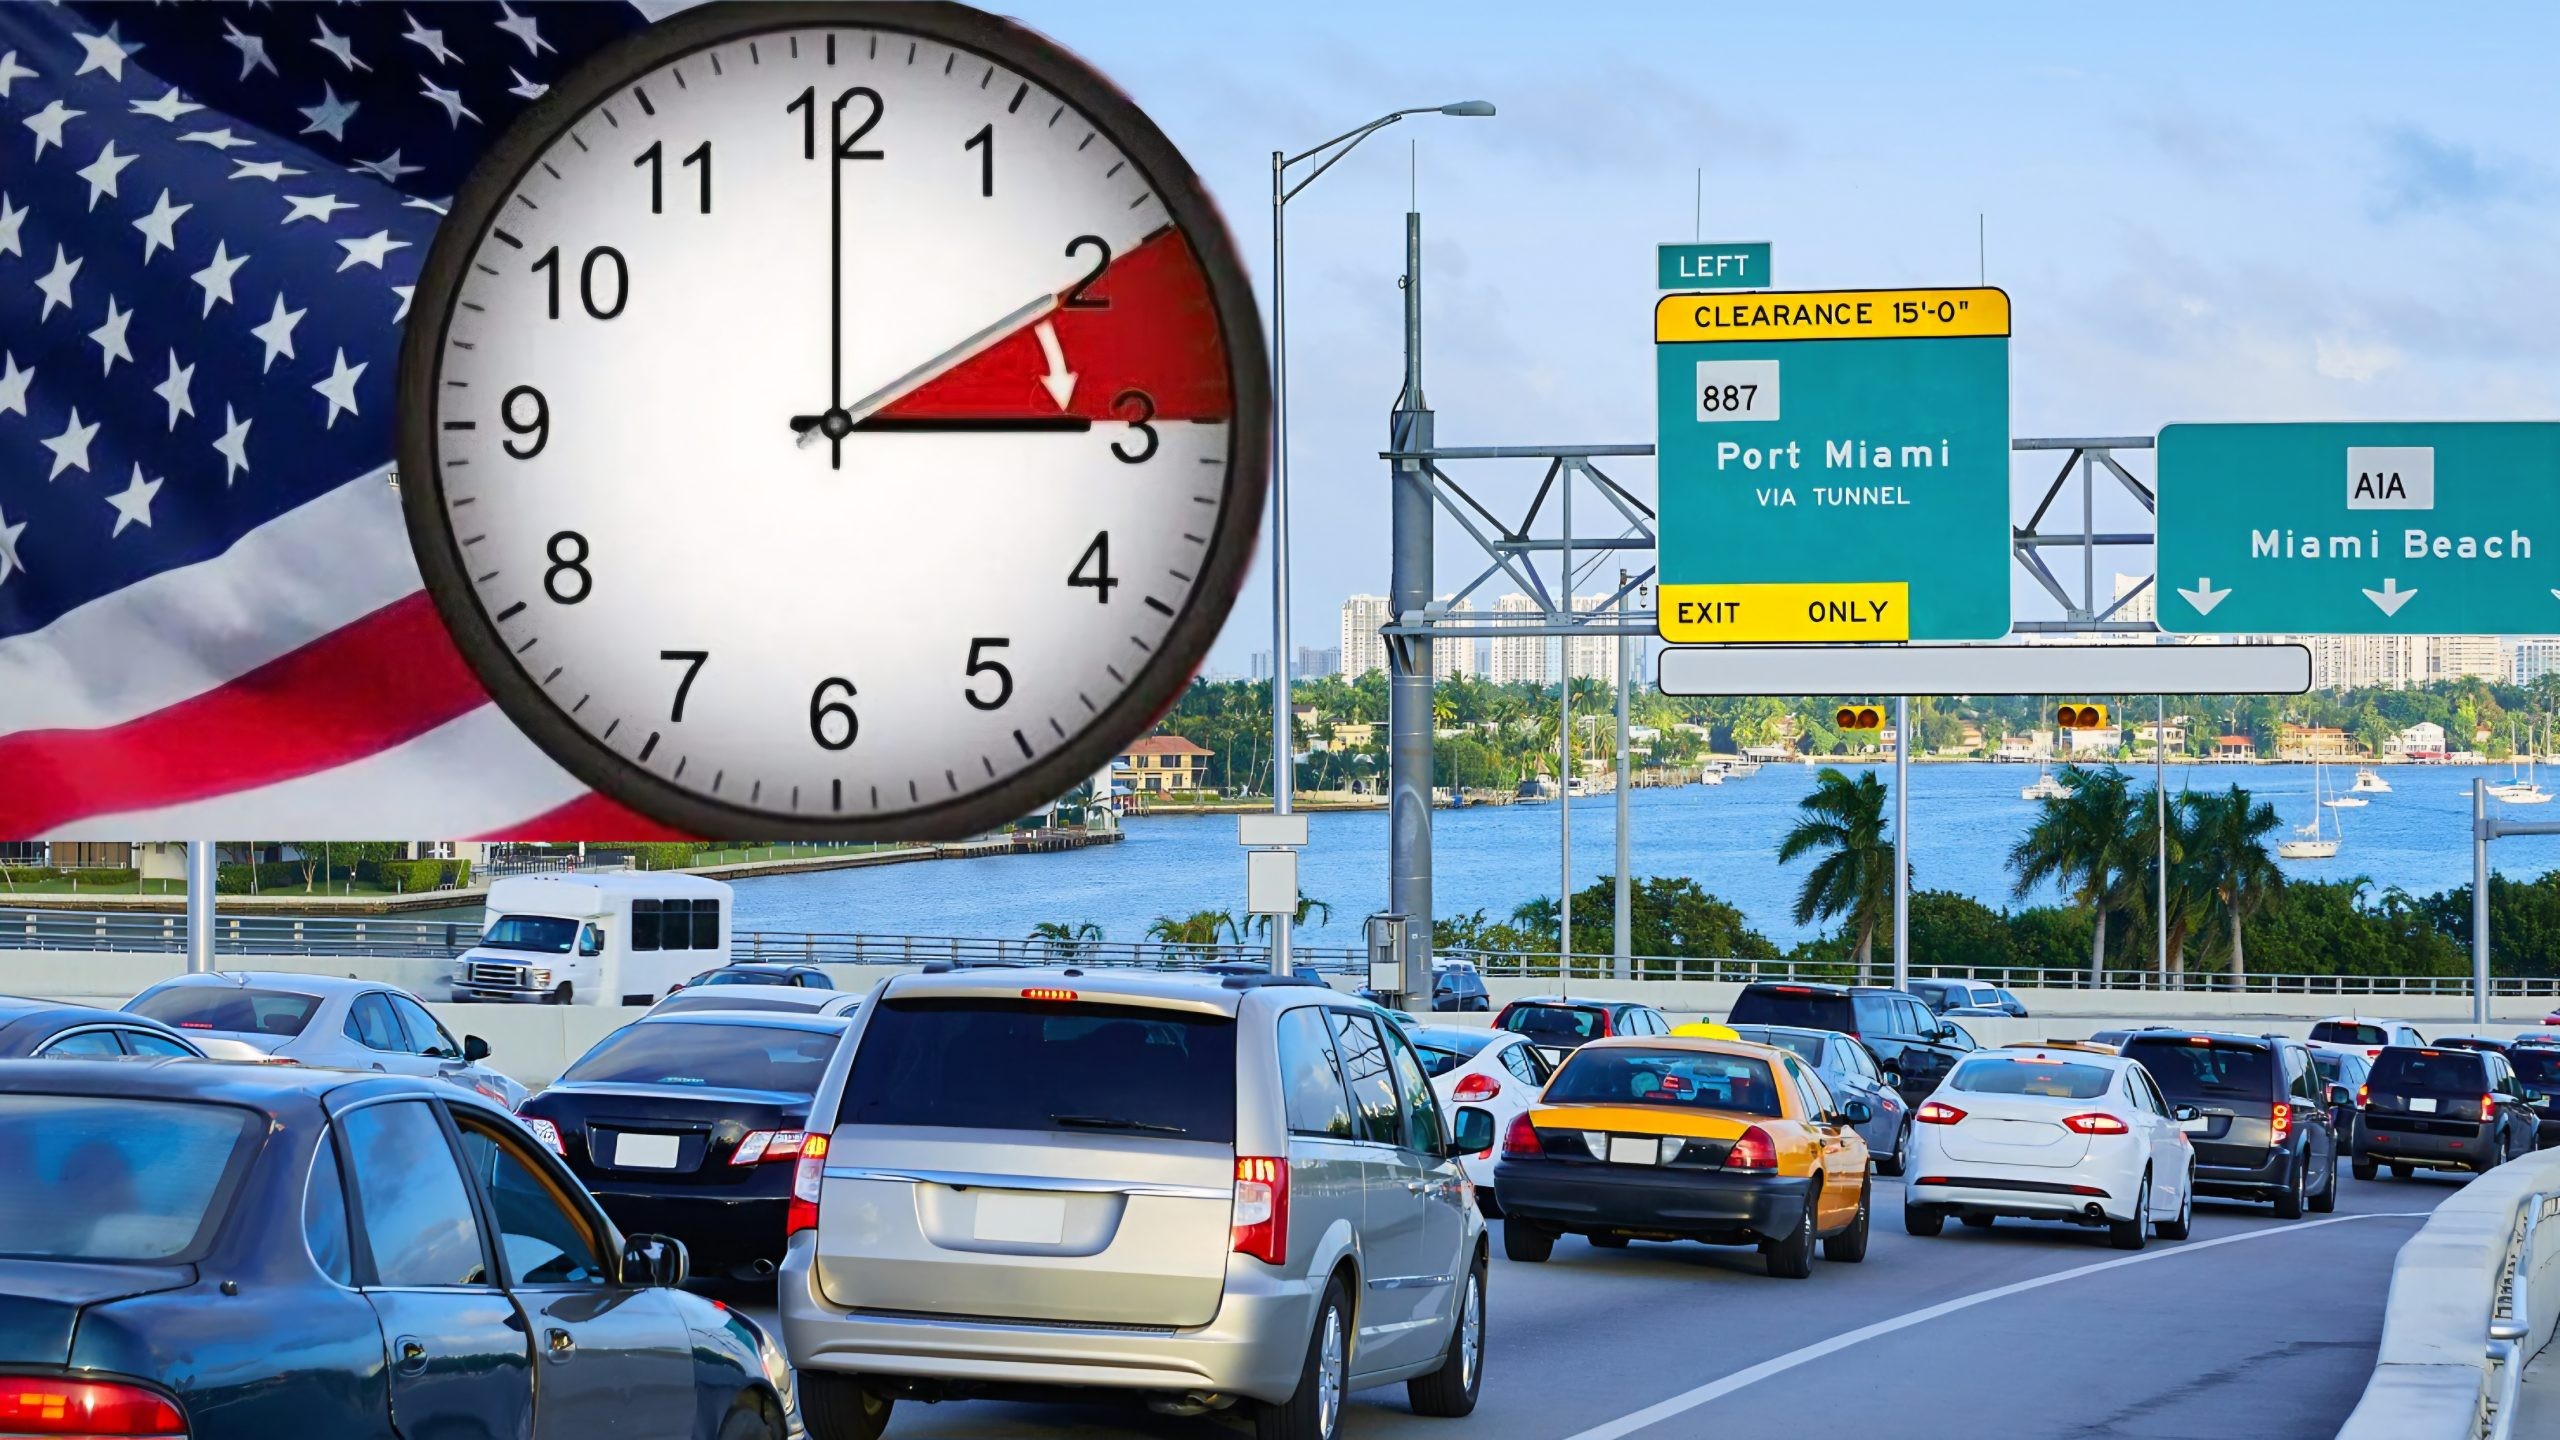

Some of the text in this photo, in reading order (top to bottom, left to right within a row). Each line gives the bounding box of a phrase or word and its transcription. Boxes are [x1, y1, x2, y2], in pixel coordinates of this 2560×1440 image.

[786, 85, 885, 161] 12
[634, 141, 711, 214] 11
[965, 124, 992, 197] 1
[532, 246, 628, 320] 10
[1063, 235, 1113, 310] 2
[1681, 255, 1748, 277] LEFT
[1694, 301, 1873, 328] CLEARANCE
[502, 385, 549, 460] 9
[1109, 388, 1160, 464] 3
[1702, 384, 1758, 412] 887
[1718, 439, 1948, 469] Port Miami
[2354, 472, 2407, 500] A1A
[1757, 487, 1910, 506] VIA TUNNEL
[544, 531, 592, 605] 8
[1068, 531, 1118, 603] 4
[2253, 530, 2530, 558] Miami Beach
[1679, 601, 1887, 623] EXIT ONLY
[661, 651, 708, 722] 7
[966, 638, 1013, 710] 5
[810, 677, 858, 750] 6
